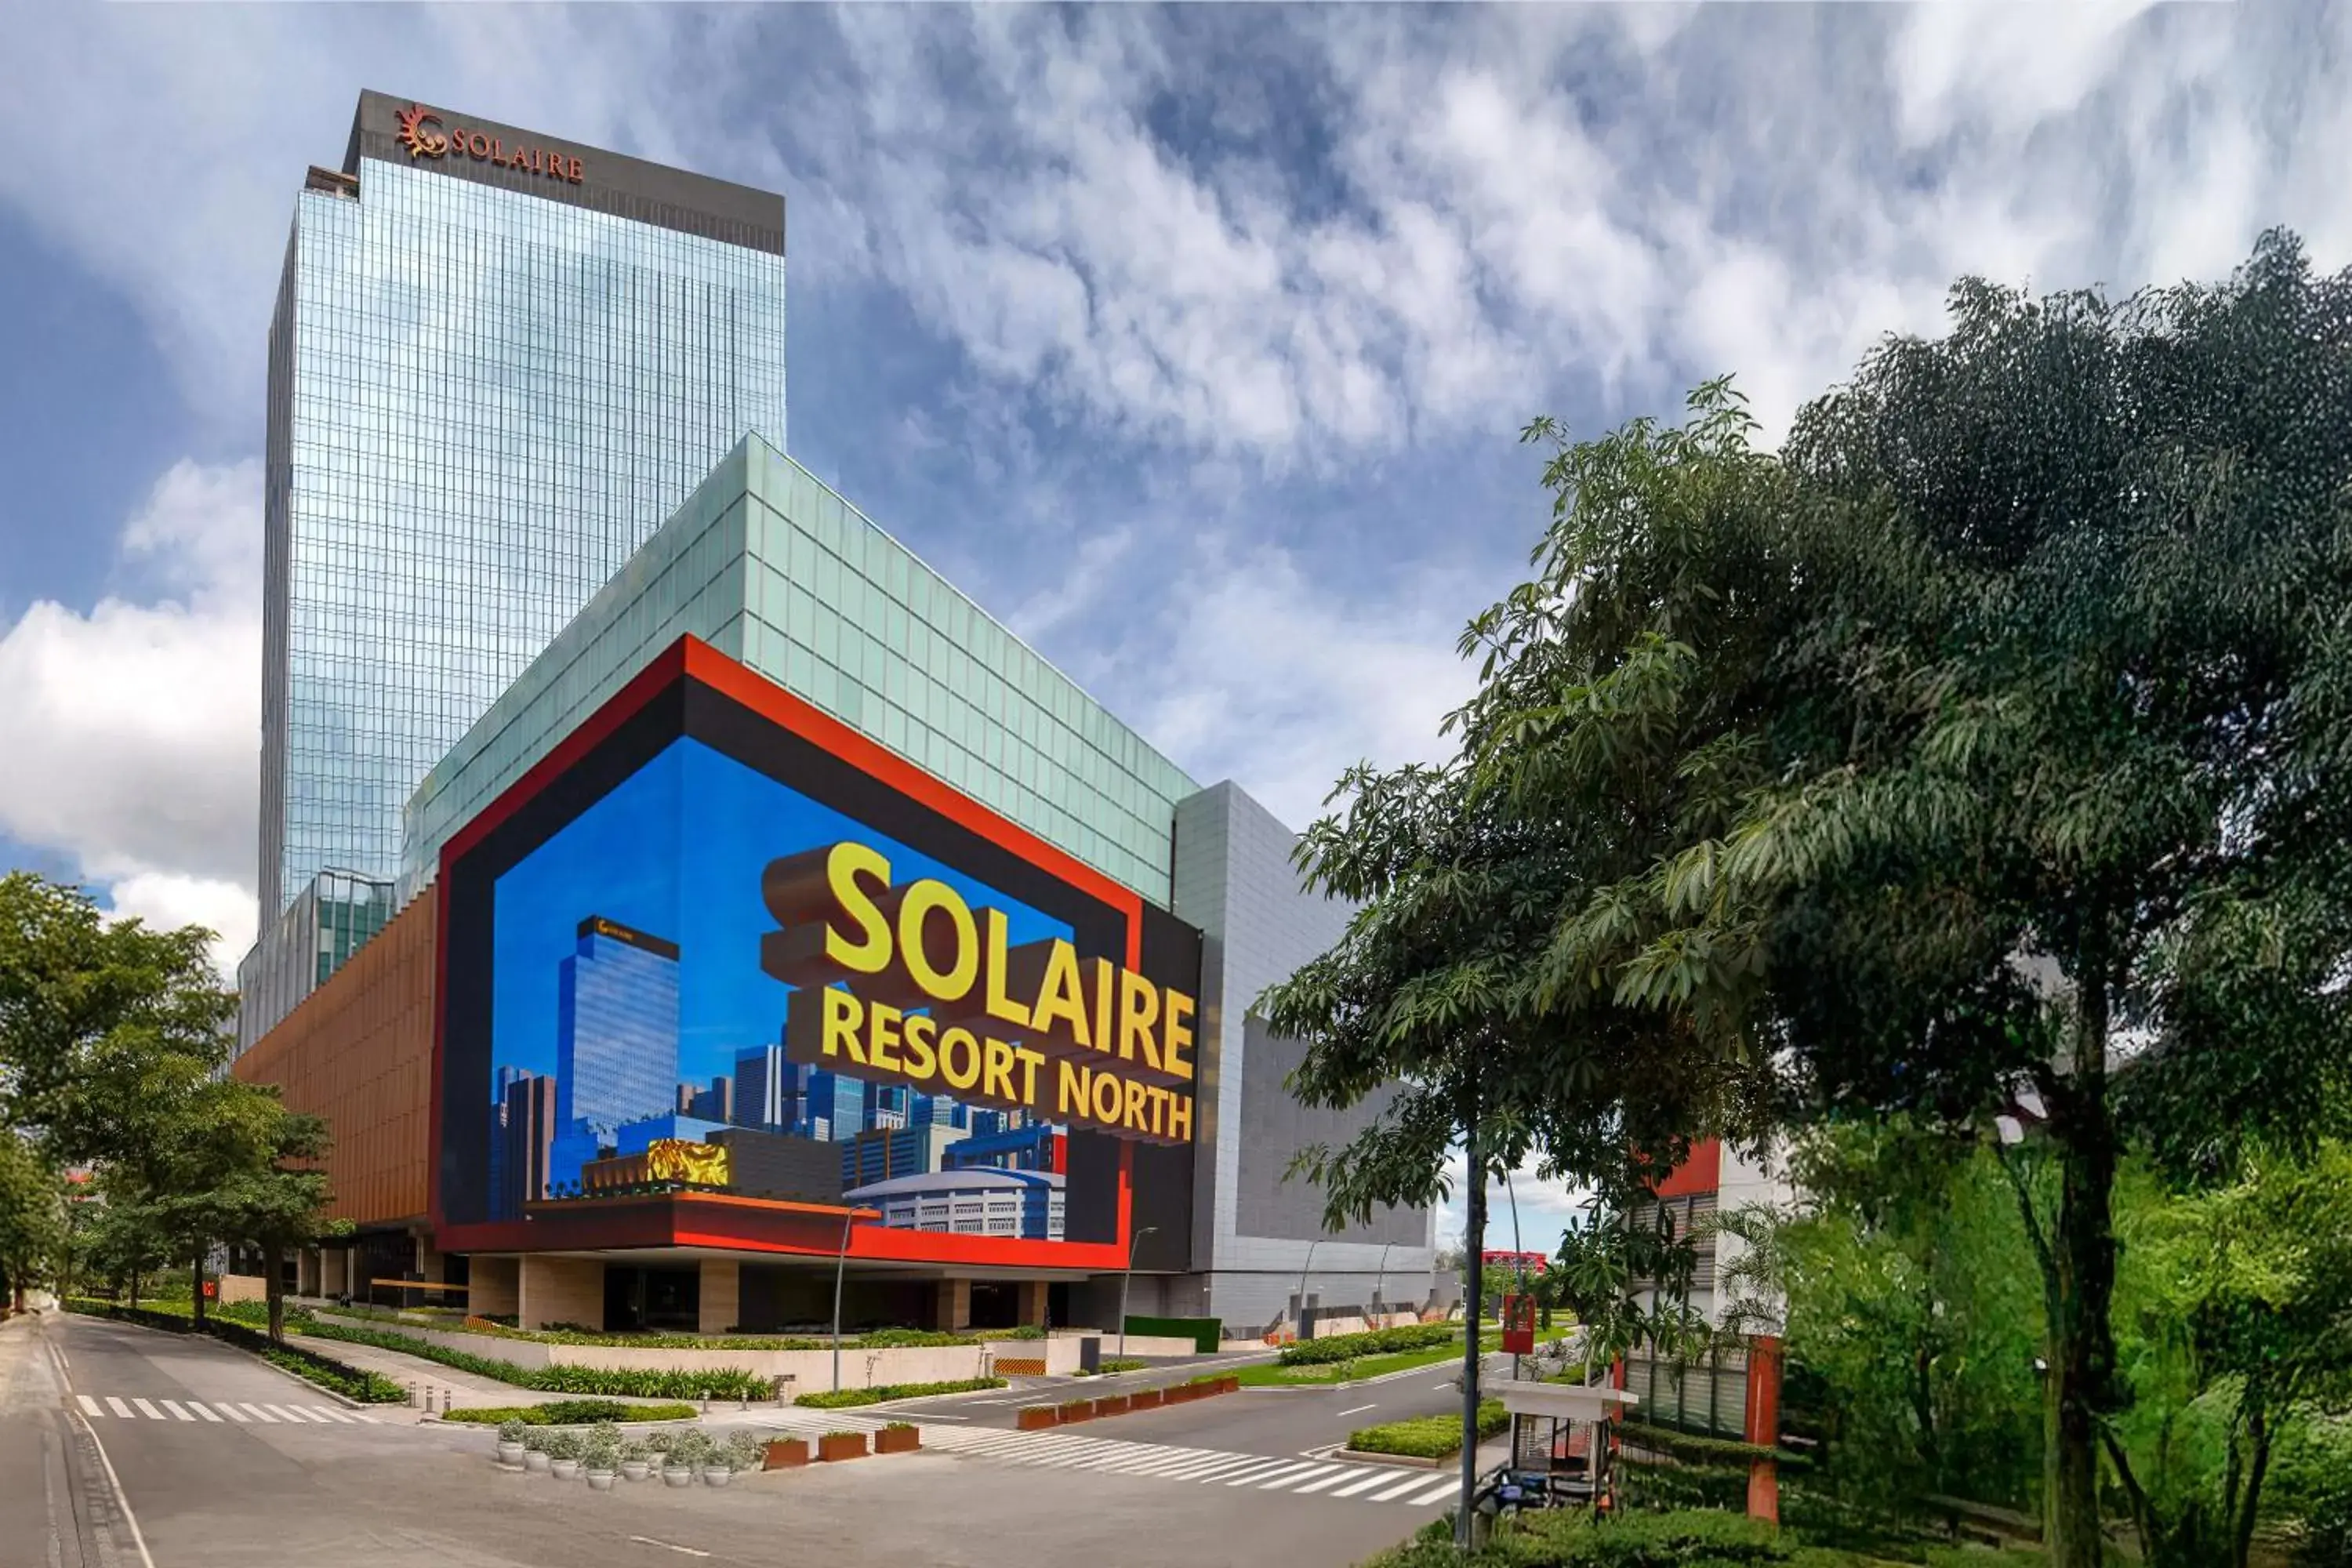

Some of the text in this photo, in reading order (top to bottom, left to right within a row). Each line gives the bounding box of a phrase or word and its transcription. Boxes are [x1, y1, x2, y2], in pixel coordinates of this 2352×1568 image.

[452, 128, 583, 183] SOLAIRE
[826, 840, 1195, 1080] SOLAIRE
[822, 985, 1192, 1142] RESORT NORTH
